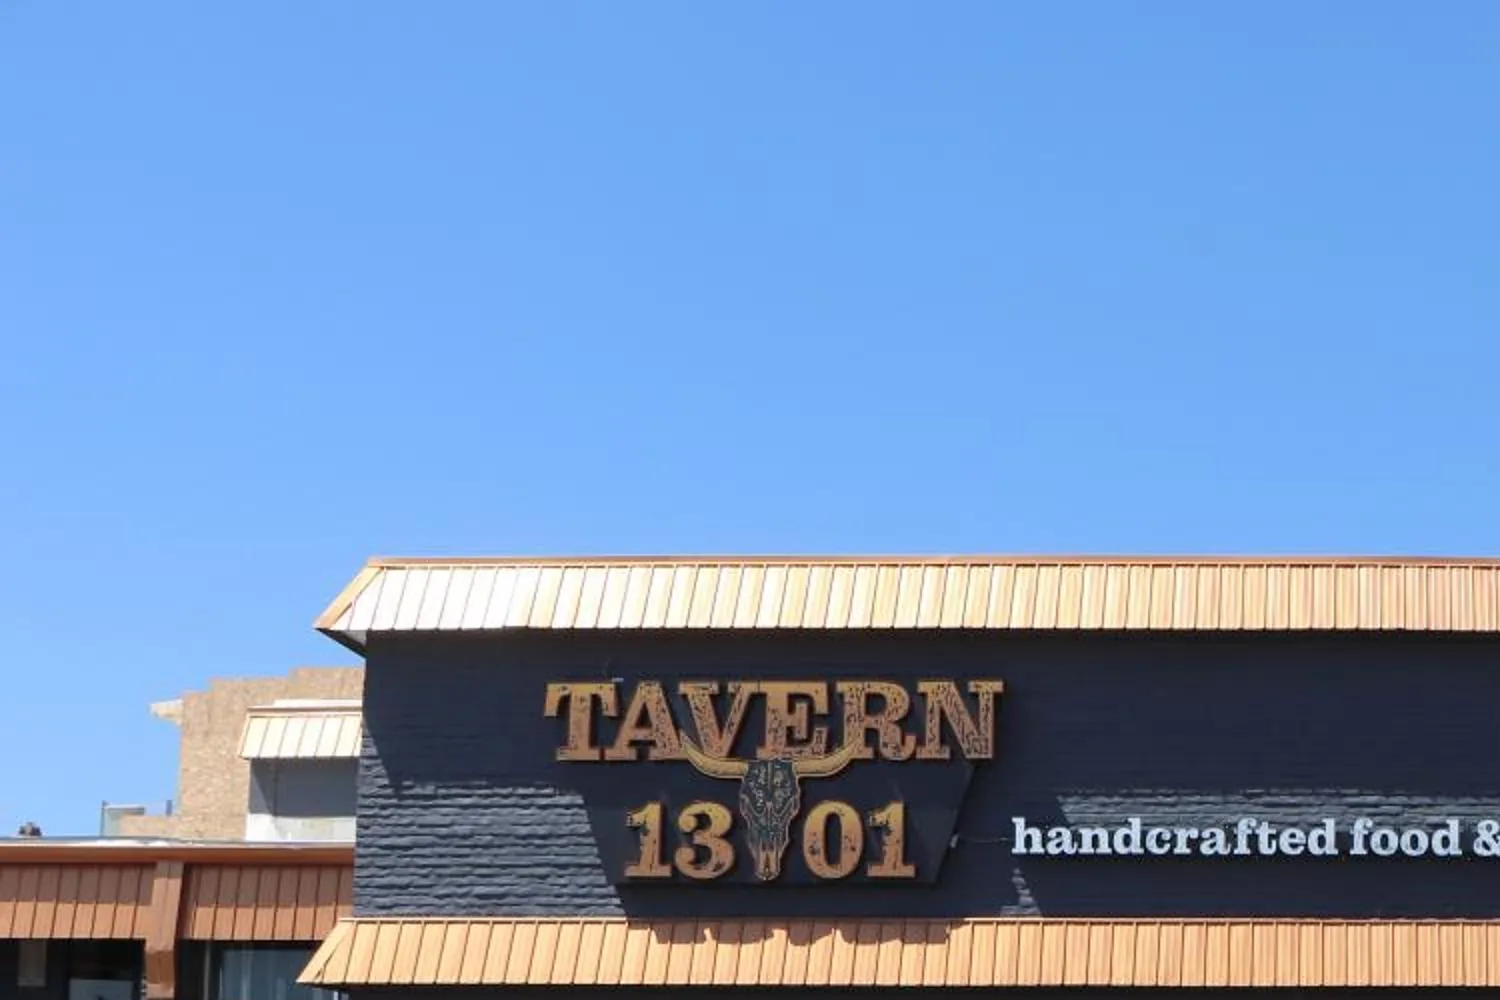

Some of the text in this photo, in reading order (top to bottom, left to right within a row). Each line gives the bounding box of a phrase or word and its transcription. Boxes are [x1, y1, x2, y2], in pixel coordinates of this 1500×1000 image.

[544, 680, 1004, 762] TAVERN
[624, 800, 734, 880] 13
[1011, 816, 1339, 855] handcrafted
[1349, 818, 1463, 857] food
